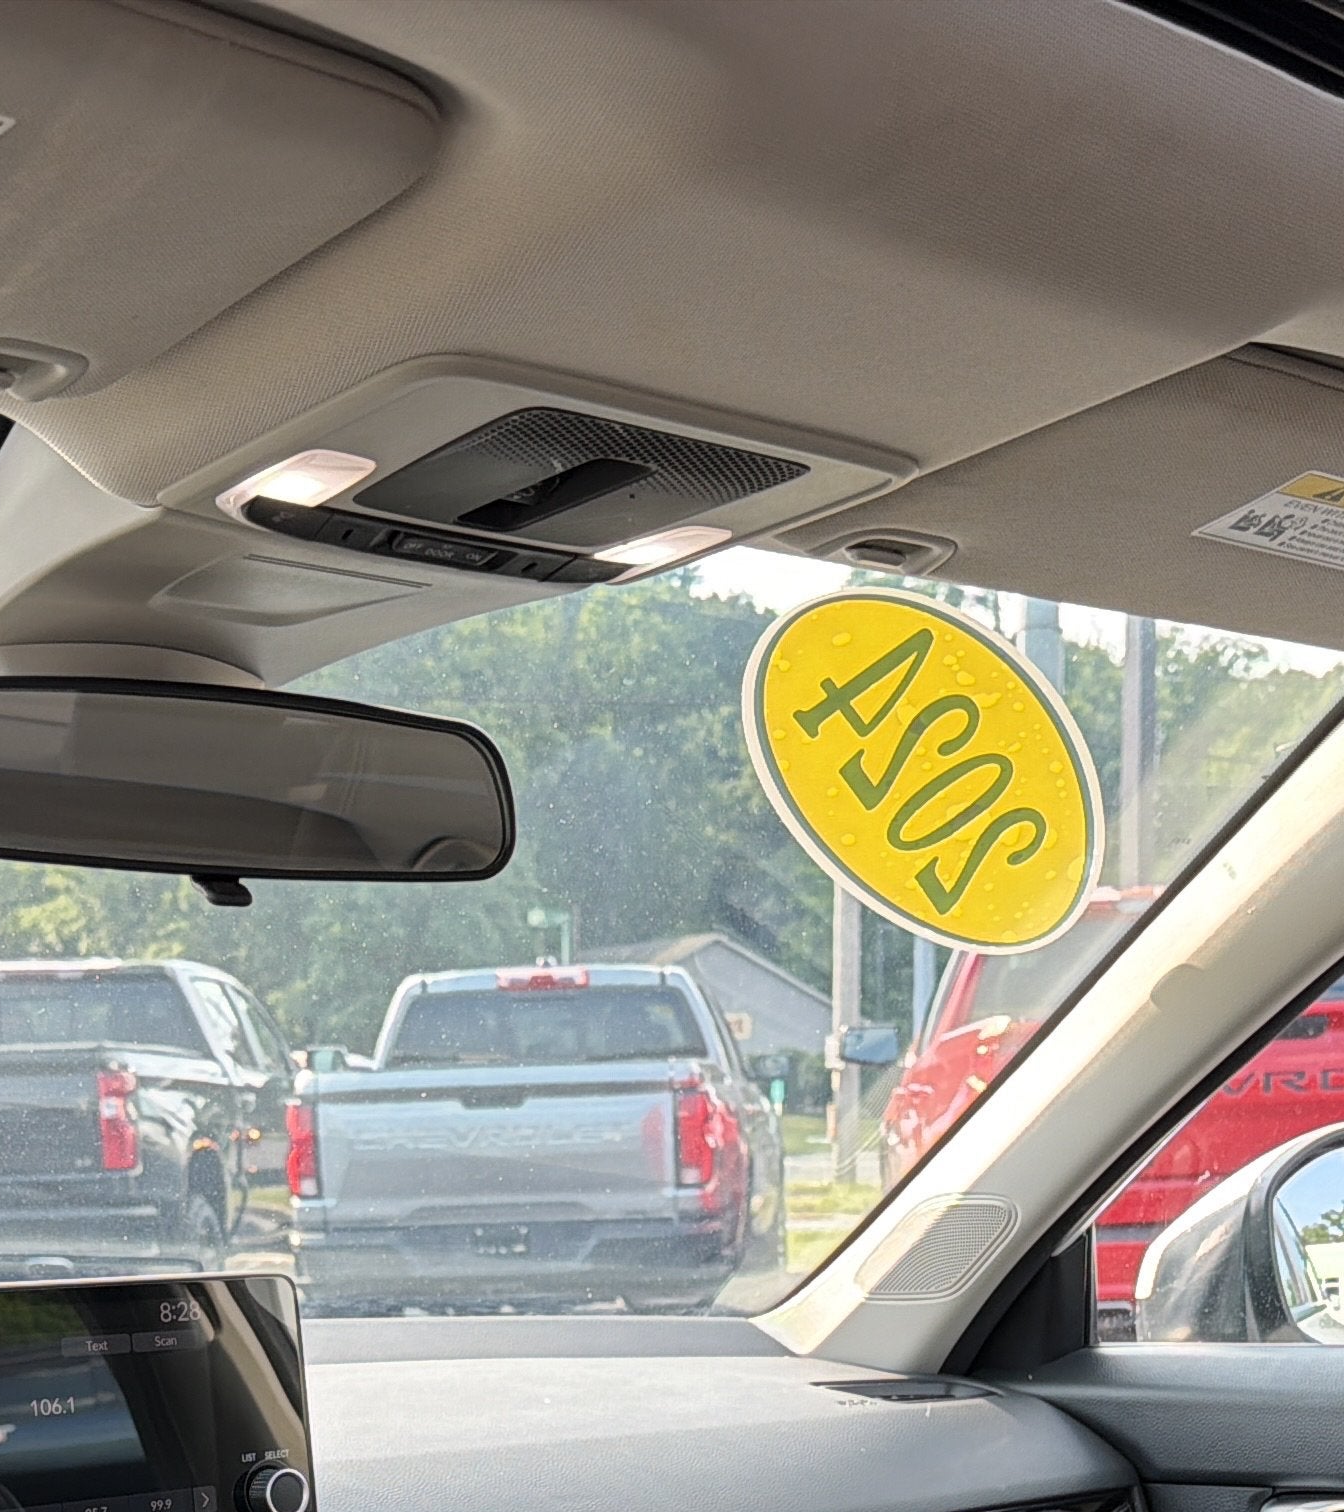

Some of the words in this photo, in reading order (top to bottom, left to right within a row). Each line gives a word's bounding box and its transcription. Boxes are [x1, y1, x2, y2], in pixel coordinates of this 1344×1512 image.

[159, 1299, 202, 1324] 8:28
[85, 1338, 109, 1354] Text
[153, 1334, 178, 1349] Scan
[29, 1396, 76, 1418] 106.1
[241, 1452, 257, 1463] LIST
[264, 1448, 290, 1461] SELECT
[149, 1497, 173, 1512] 99.9
